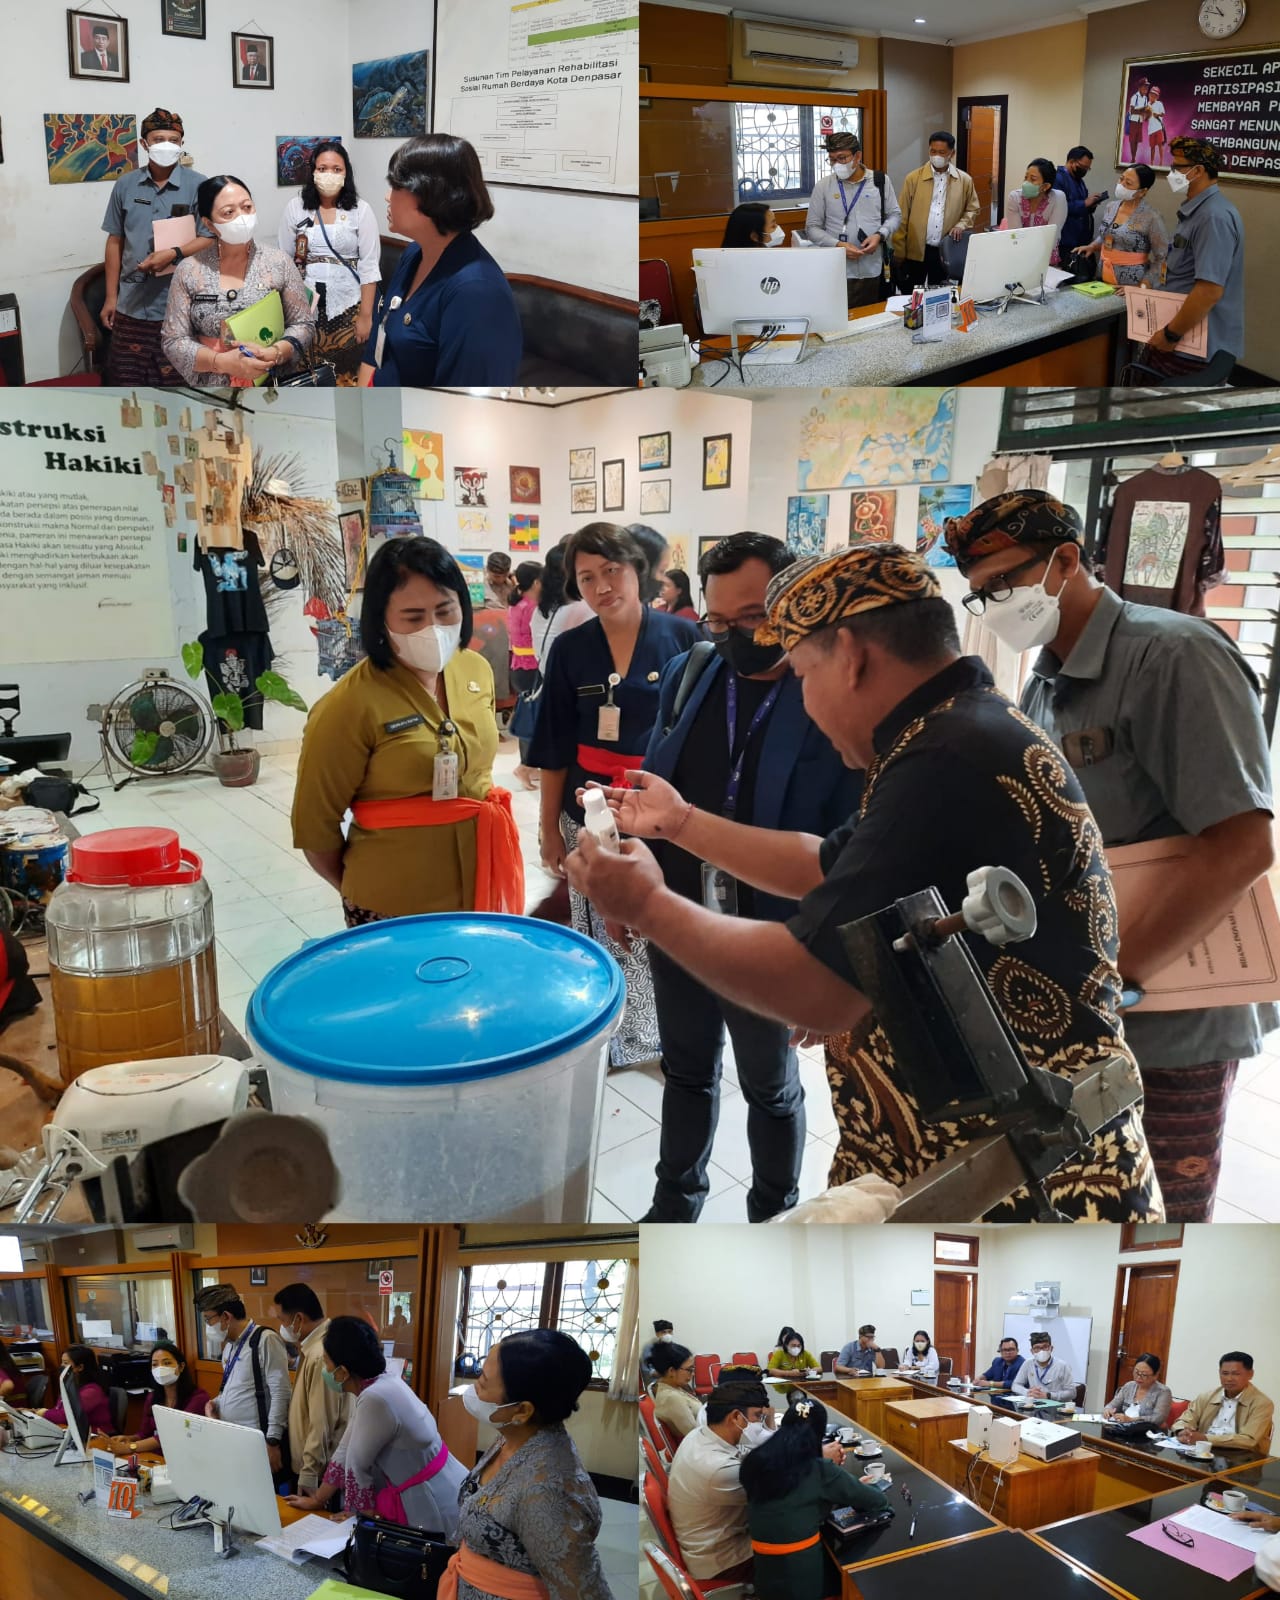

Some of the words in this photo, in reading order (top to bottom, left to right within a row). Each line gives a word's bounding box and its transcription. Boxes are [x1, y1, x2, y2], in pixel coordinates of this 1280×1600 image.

[463, 73, 494, 83] Susunan
[496, 71, 510, 80] Tim
[511, 66, 556, 78] Pelayanan
[558, 59, 618, 72] Rehabilitasi
[1203, 63, 1258, 78] SEKECIL
[1262, 61, 1280, 75] AP
[460, 83, 481, 92] Sosial
[482, 81, 509, 90] Rumah
[510, 78, 545, 88] Berdaya
[546, 76, 568, 85] Kota
[570, 72, 622, 83] Denpasar
[1194, 80, 1280, 96] PARTISIPASI
[1197, 100, 1260, 113] MEMBAYAR
[1269, 100, 1280, 112] P
[1190, 119, 1236, 131] SANGAT
[1205, 136, 1280, 150] PEMBANGUN
[762, 275, 779, 296] hp
[0, 419, 106, 443] struksi
[44, 451, 142, 475] Hakiki
[0, 489, 16, 498] kiki
[0, 500, 25, 508] katan
[112, 1484, 132, 1510] 10
